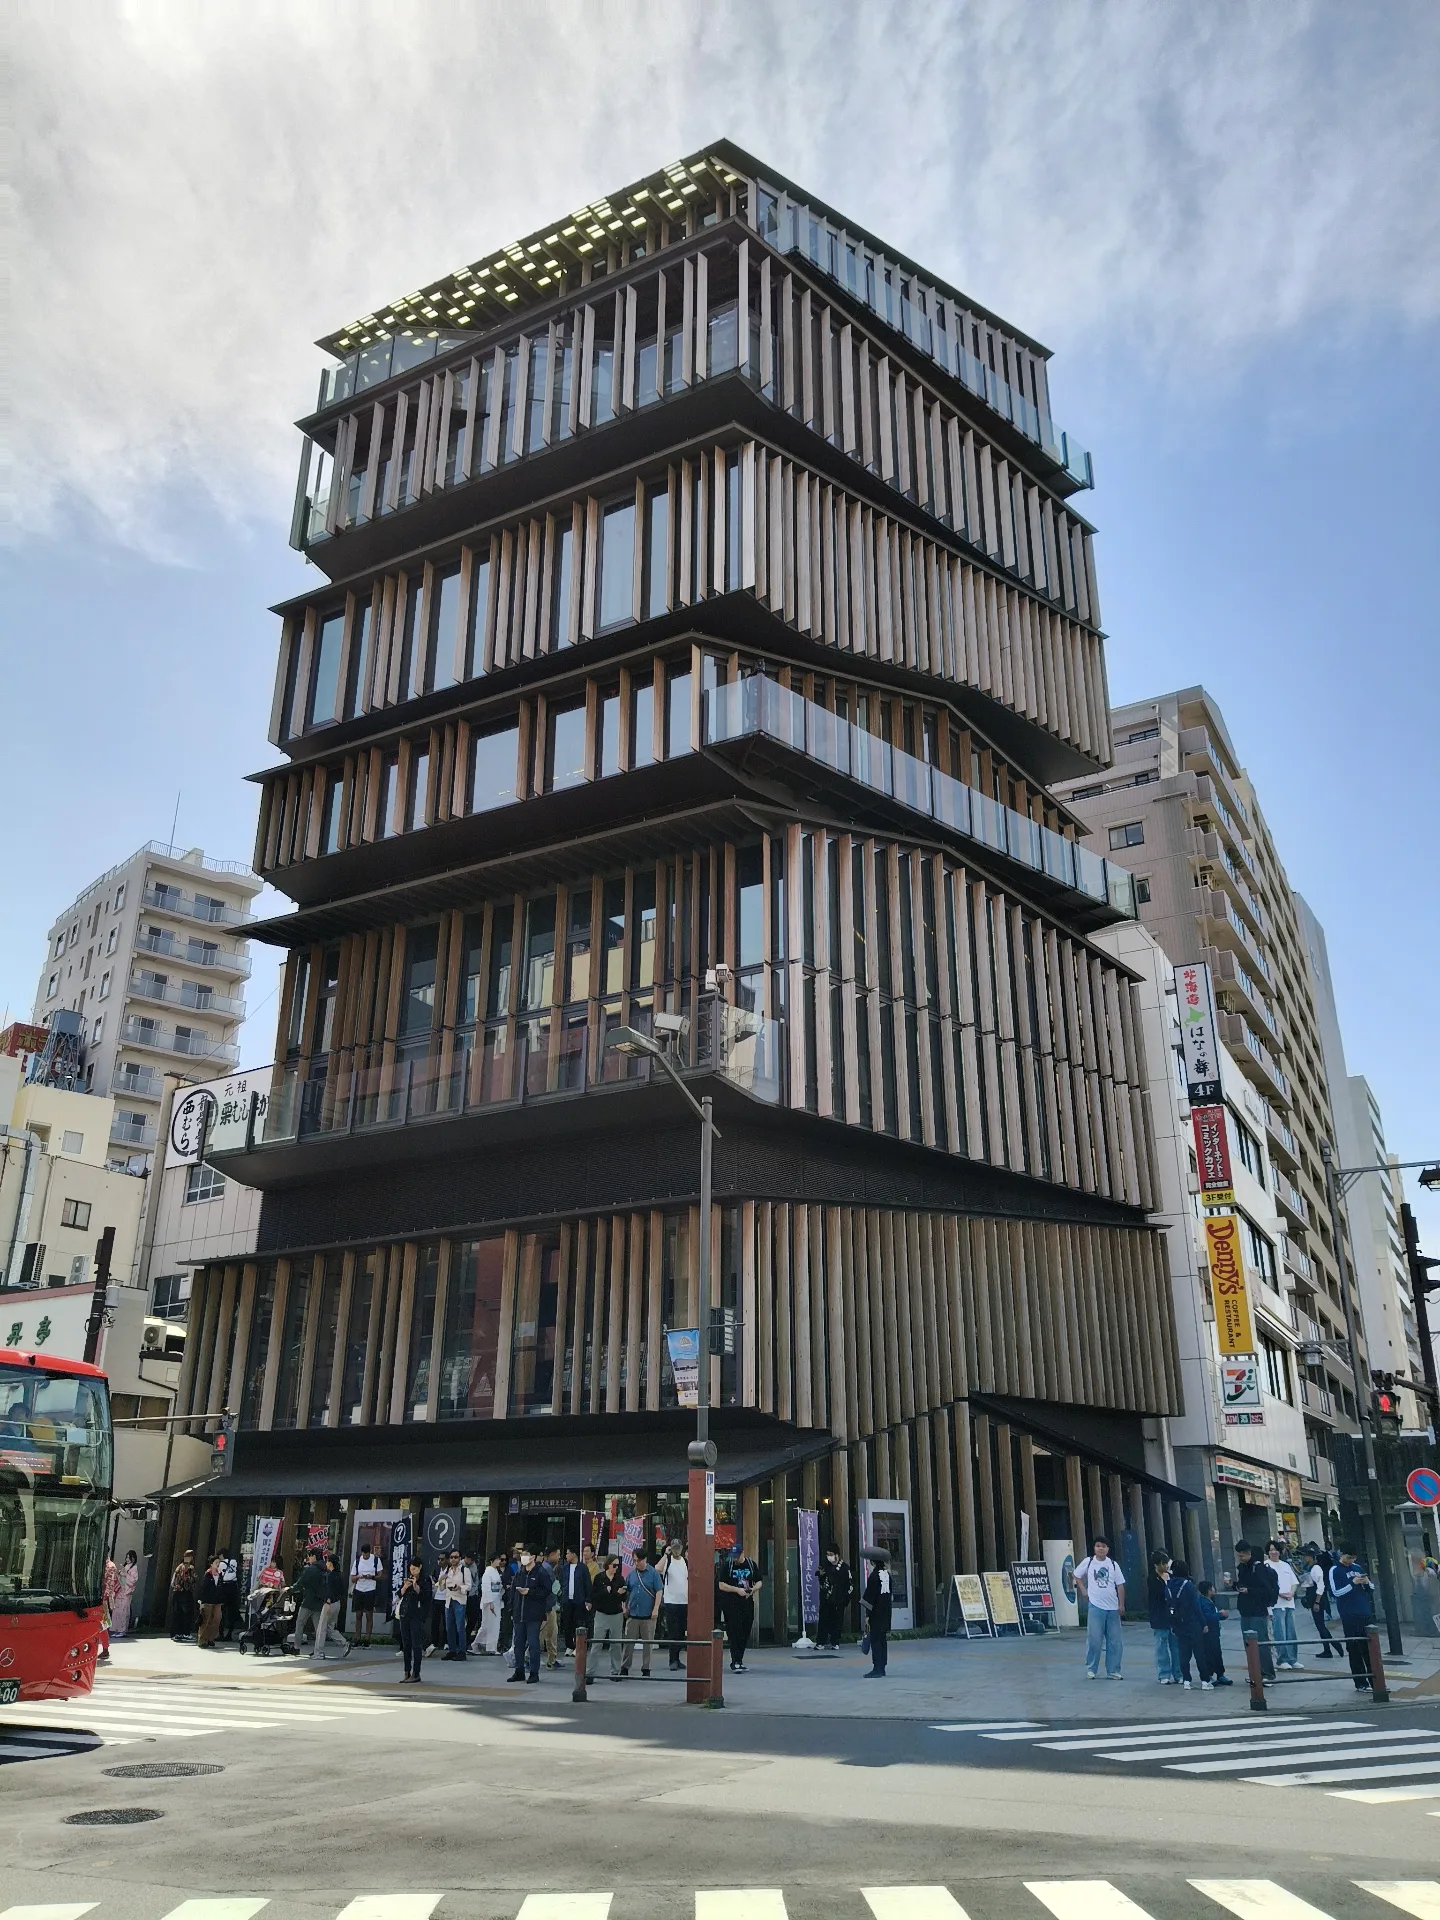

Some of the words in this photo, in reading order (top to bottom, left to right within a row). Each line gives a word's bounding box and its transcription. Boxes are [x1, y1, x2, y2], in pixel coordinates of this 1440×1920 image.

[1190, 1026, 1210, 1077] はなの舞
[224, 1080, 247, 1097] 元祖
[1195, 1084, 1215, 1097] 4F
[180, 1100, 195, 1150] 西むら
[1201, 1124, 1216, 1179] コミックカフェ
[1205, 1192, 1232, 1202] 3F受付
[1207, 1220, 1244, 1295] Denny's
[1224, 1300, 1236, 1349] RESTAURANT
[1231, 1300, 1241, 1327] COFFEE
[1017, 1577, 1048, 1585] CURRENCY
